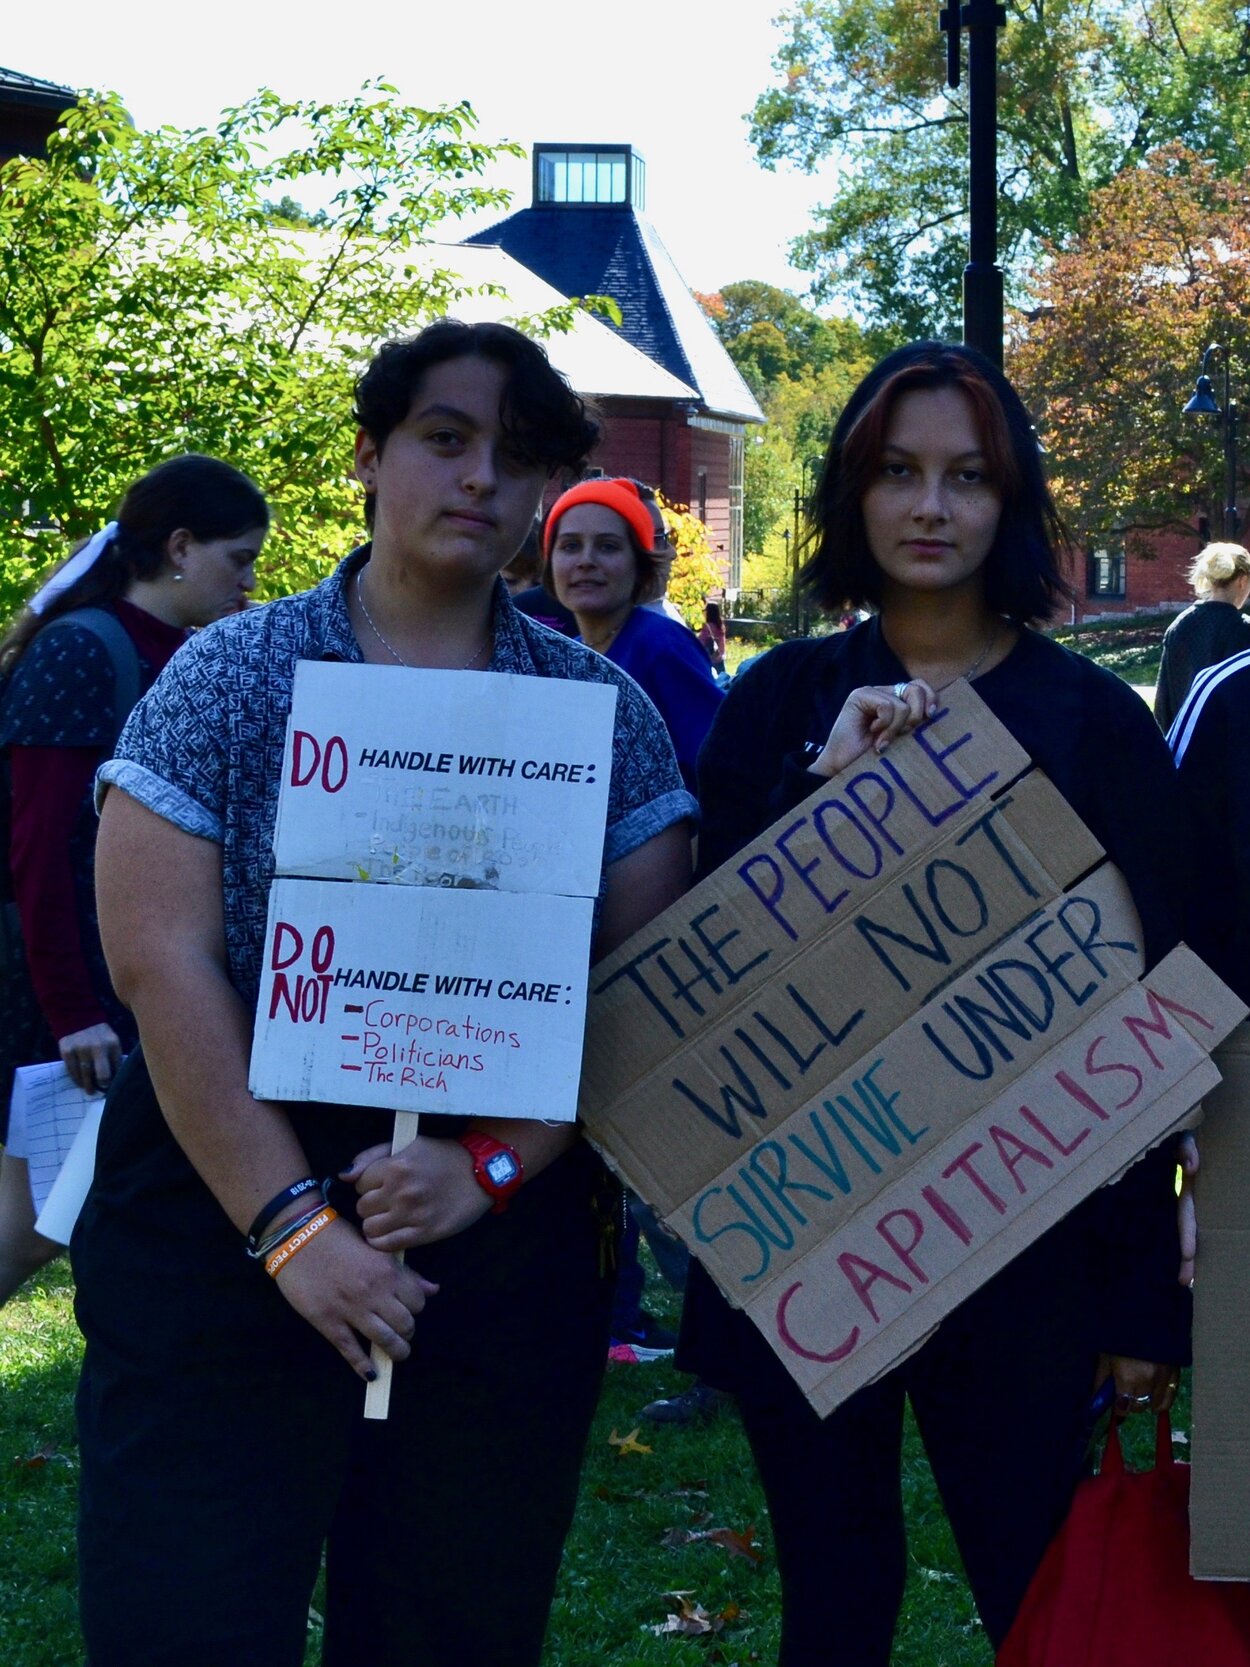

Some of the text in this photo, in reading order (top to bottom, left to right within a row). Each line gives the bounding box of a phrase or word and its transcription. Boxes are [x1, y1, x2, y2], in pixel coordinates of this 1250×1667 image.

[291, 730, 348, 793] DO
[359, 749, 453, 773] HANDLE
[459, 755, 516, 777] WITH
[591, 707, 999, 1040] THE PEOPLE
[272, 922, 335, 974] DO
[673, 796, 1045, 1139] WILL NOT
[269, 973, 335, 1024] NOT
[333, 968, 429, 994] HANDLE
[435, 975, 492, 998] WITH
[401, 1067, 447, 1092] Rich
[692, 896, 1138, 1282] SURVIVE UNDER
[774, 989, 1215, 1363] CAPITALISM
[288, 1214, 328, 1252] PROTECT
